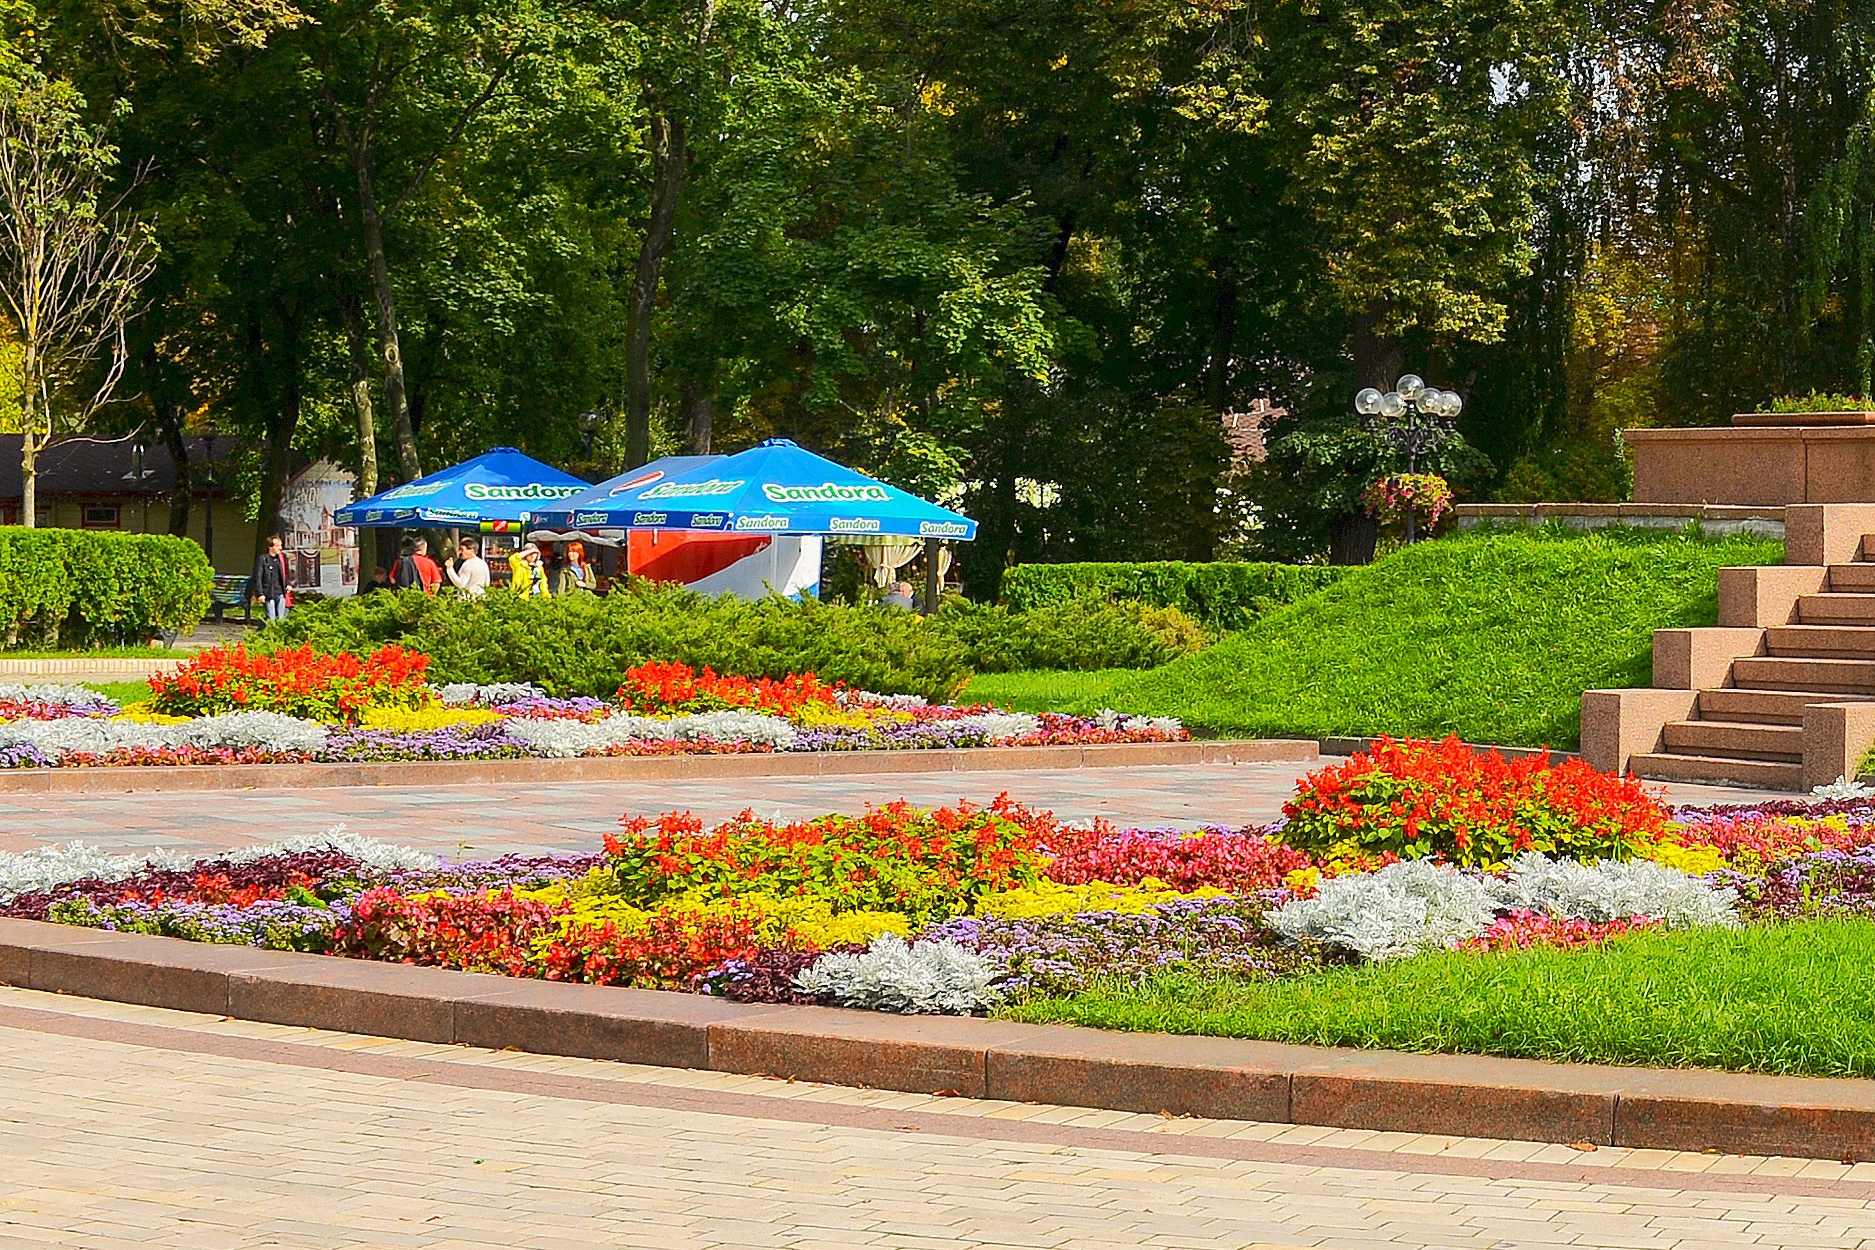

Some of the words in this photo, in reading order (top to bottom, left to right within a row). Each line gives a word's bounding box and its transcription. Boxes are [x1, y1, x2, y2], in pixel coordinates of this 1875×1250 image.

[766, 484, 885, 501] Sandora
[635, 513, 667, 525] Sandora
[691, 515, 723, 526] Sandora
[737, 517, 788, 529] Sandora
[831, 519, 879, 531] Sandora
[920, 521, 967, 534] Sandora
